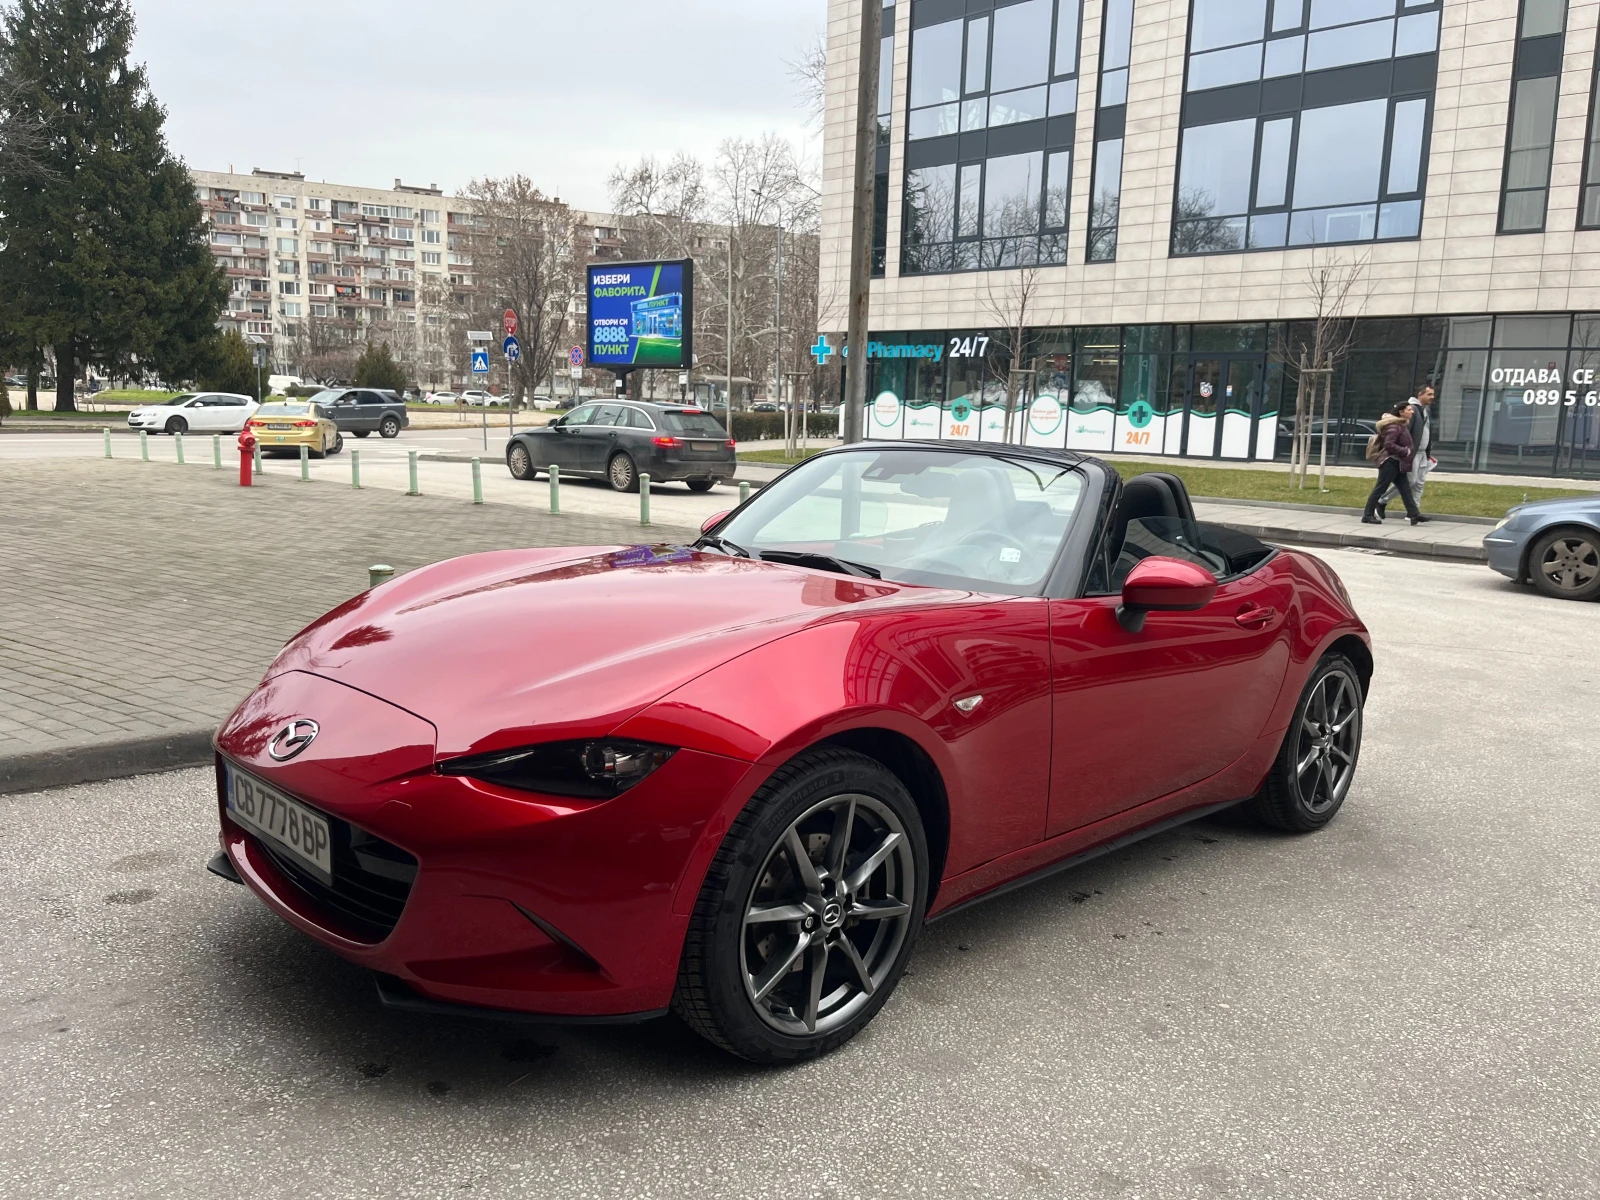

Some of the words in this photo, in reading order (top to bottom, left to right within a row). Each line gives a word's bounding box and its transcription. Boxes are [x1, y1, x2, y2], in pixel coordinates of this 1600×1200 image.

[593, 274, 630, 285] ИЗБЕРИ
[593, 286, 646, 298] ФАВОРИТА
[505, 317, 516, 328] STOP
[619, 318, 628, 326] СИ
[593, 344, 629, 355] ПУНКТ
[950, 337, 990, 358] 24/7
[1491, 368, 1561, 387] ОТДАВА
[1572, 369, 1594, 385] СЕ
[950, 424, 969, 436] 24/7
[1126, 431, 1151, 445] 24/7
[765, 777, 828, 831] SnowMaster
